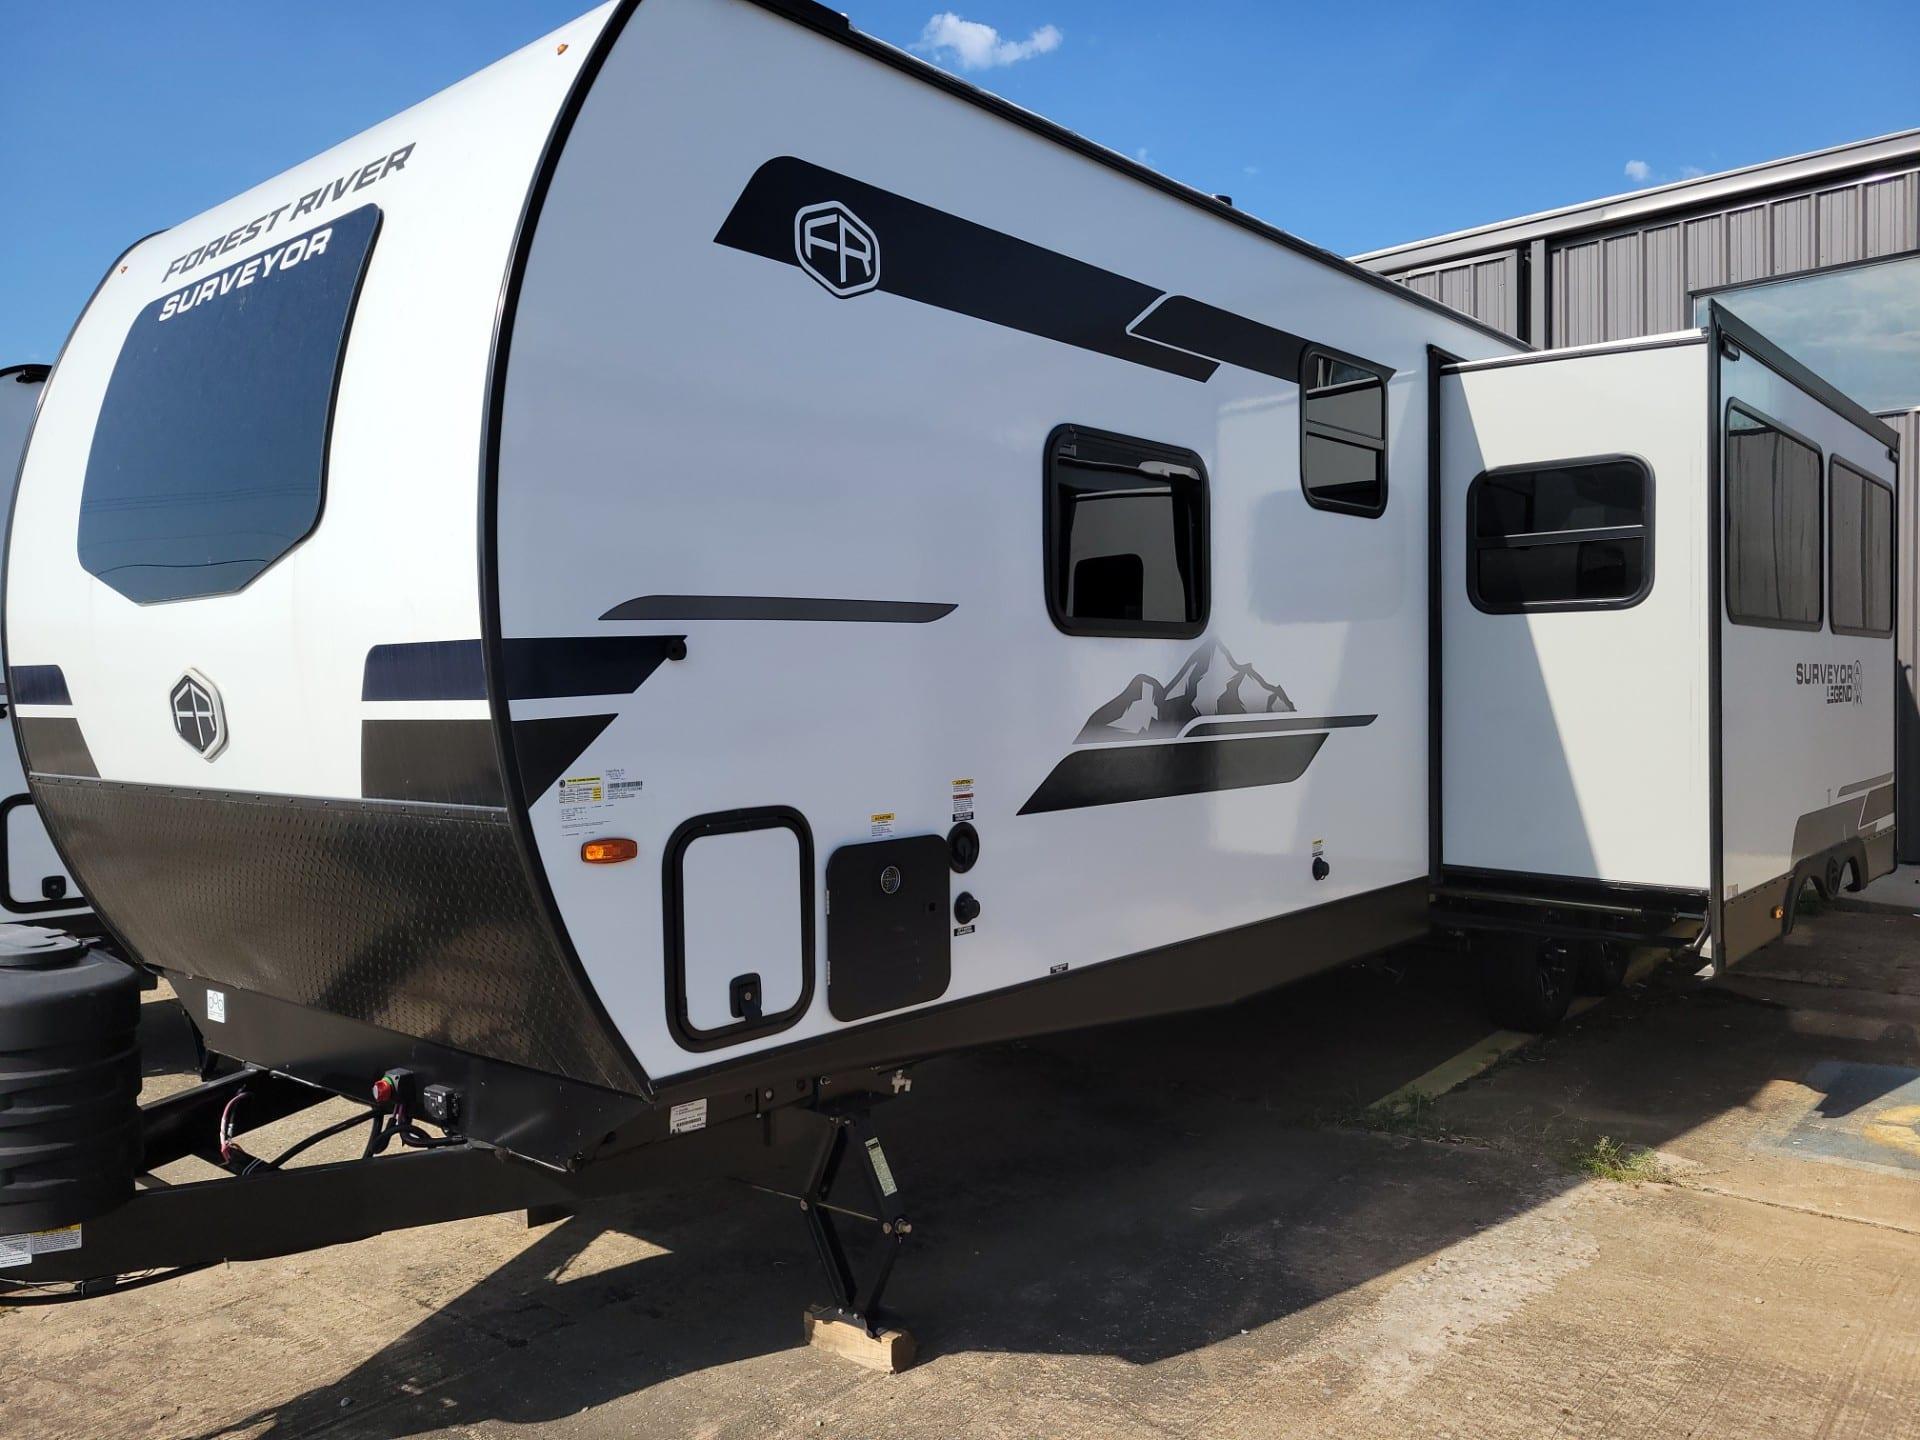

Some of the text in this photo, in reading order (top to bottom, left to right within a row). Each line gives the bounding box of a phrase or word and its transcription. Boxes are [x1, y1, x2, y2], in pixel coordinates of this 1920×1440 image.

[162, 142, 416, 283] FOREST RIVER
[158, 228, 332, 322] SURVEYOR
[1796, 663, 1853, 685] SURVEYOR
[1826, 684, 1852, 703] LEGEND
